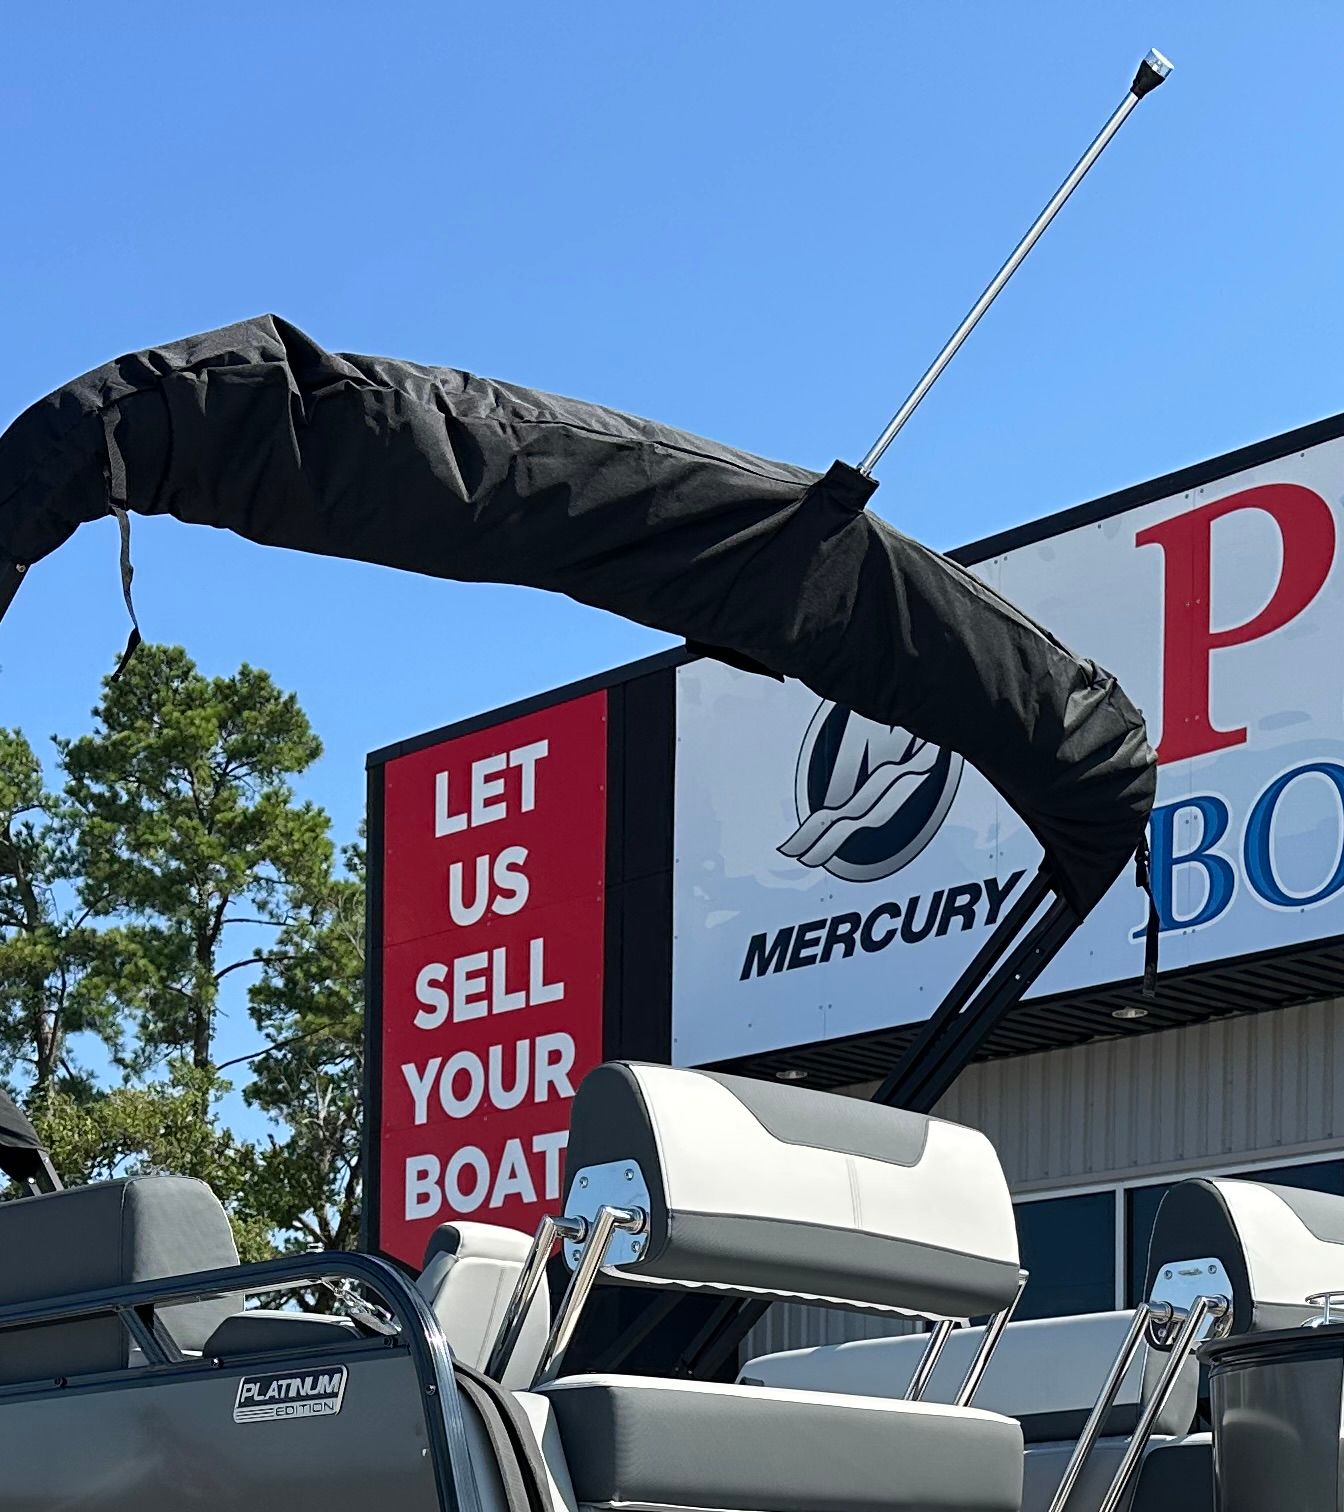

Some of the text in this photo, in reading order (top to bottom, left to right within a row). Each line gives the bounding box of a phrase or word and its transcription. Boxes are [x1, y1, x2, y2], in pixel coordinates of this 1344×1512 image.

[434, 739, 549, 839] LET
[448, 846, 529, 926] US
[739, 868, 1027, 981] MERCURY
[413, 937, 565, 1030] SELL
[401, 1032, 575, 1126] YOUR
[405, 1131, 569, 1221] BOAT
[240, 1373, 342, 1403] PLATINUM
[275, 1401, 334, 1416] EDITION
